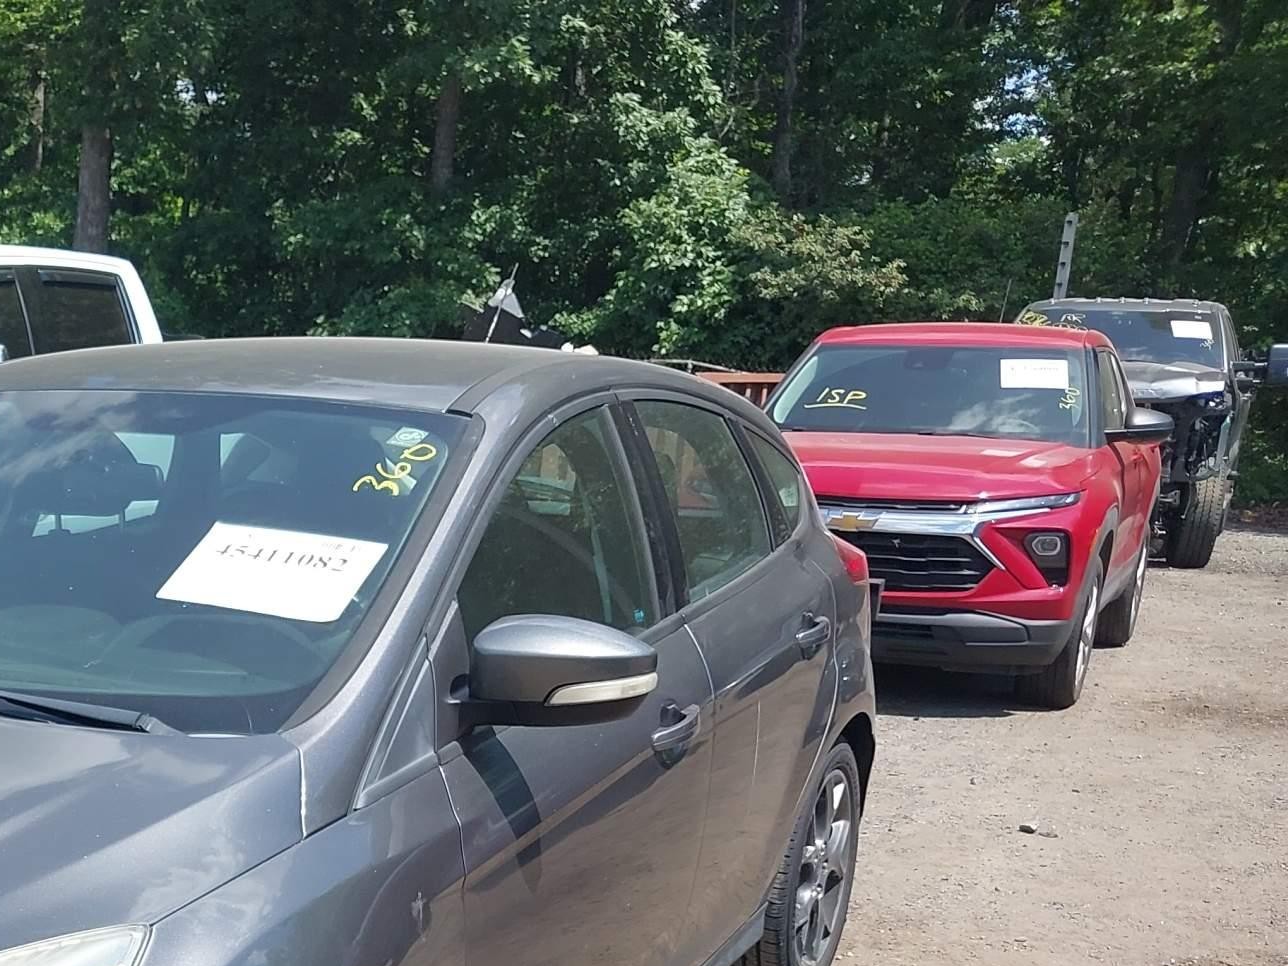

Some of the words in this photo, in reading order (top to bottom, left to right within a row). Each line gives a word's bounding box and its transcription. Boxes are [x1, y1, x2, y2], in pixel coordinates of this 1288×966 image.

[1059, 387, 1080, 410] 360
[353, 443, 436, 496] 360
[215, 543, 349, 572] 45411082
